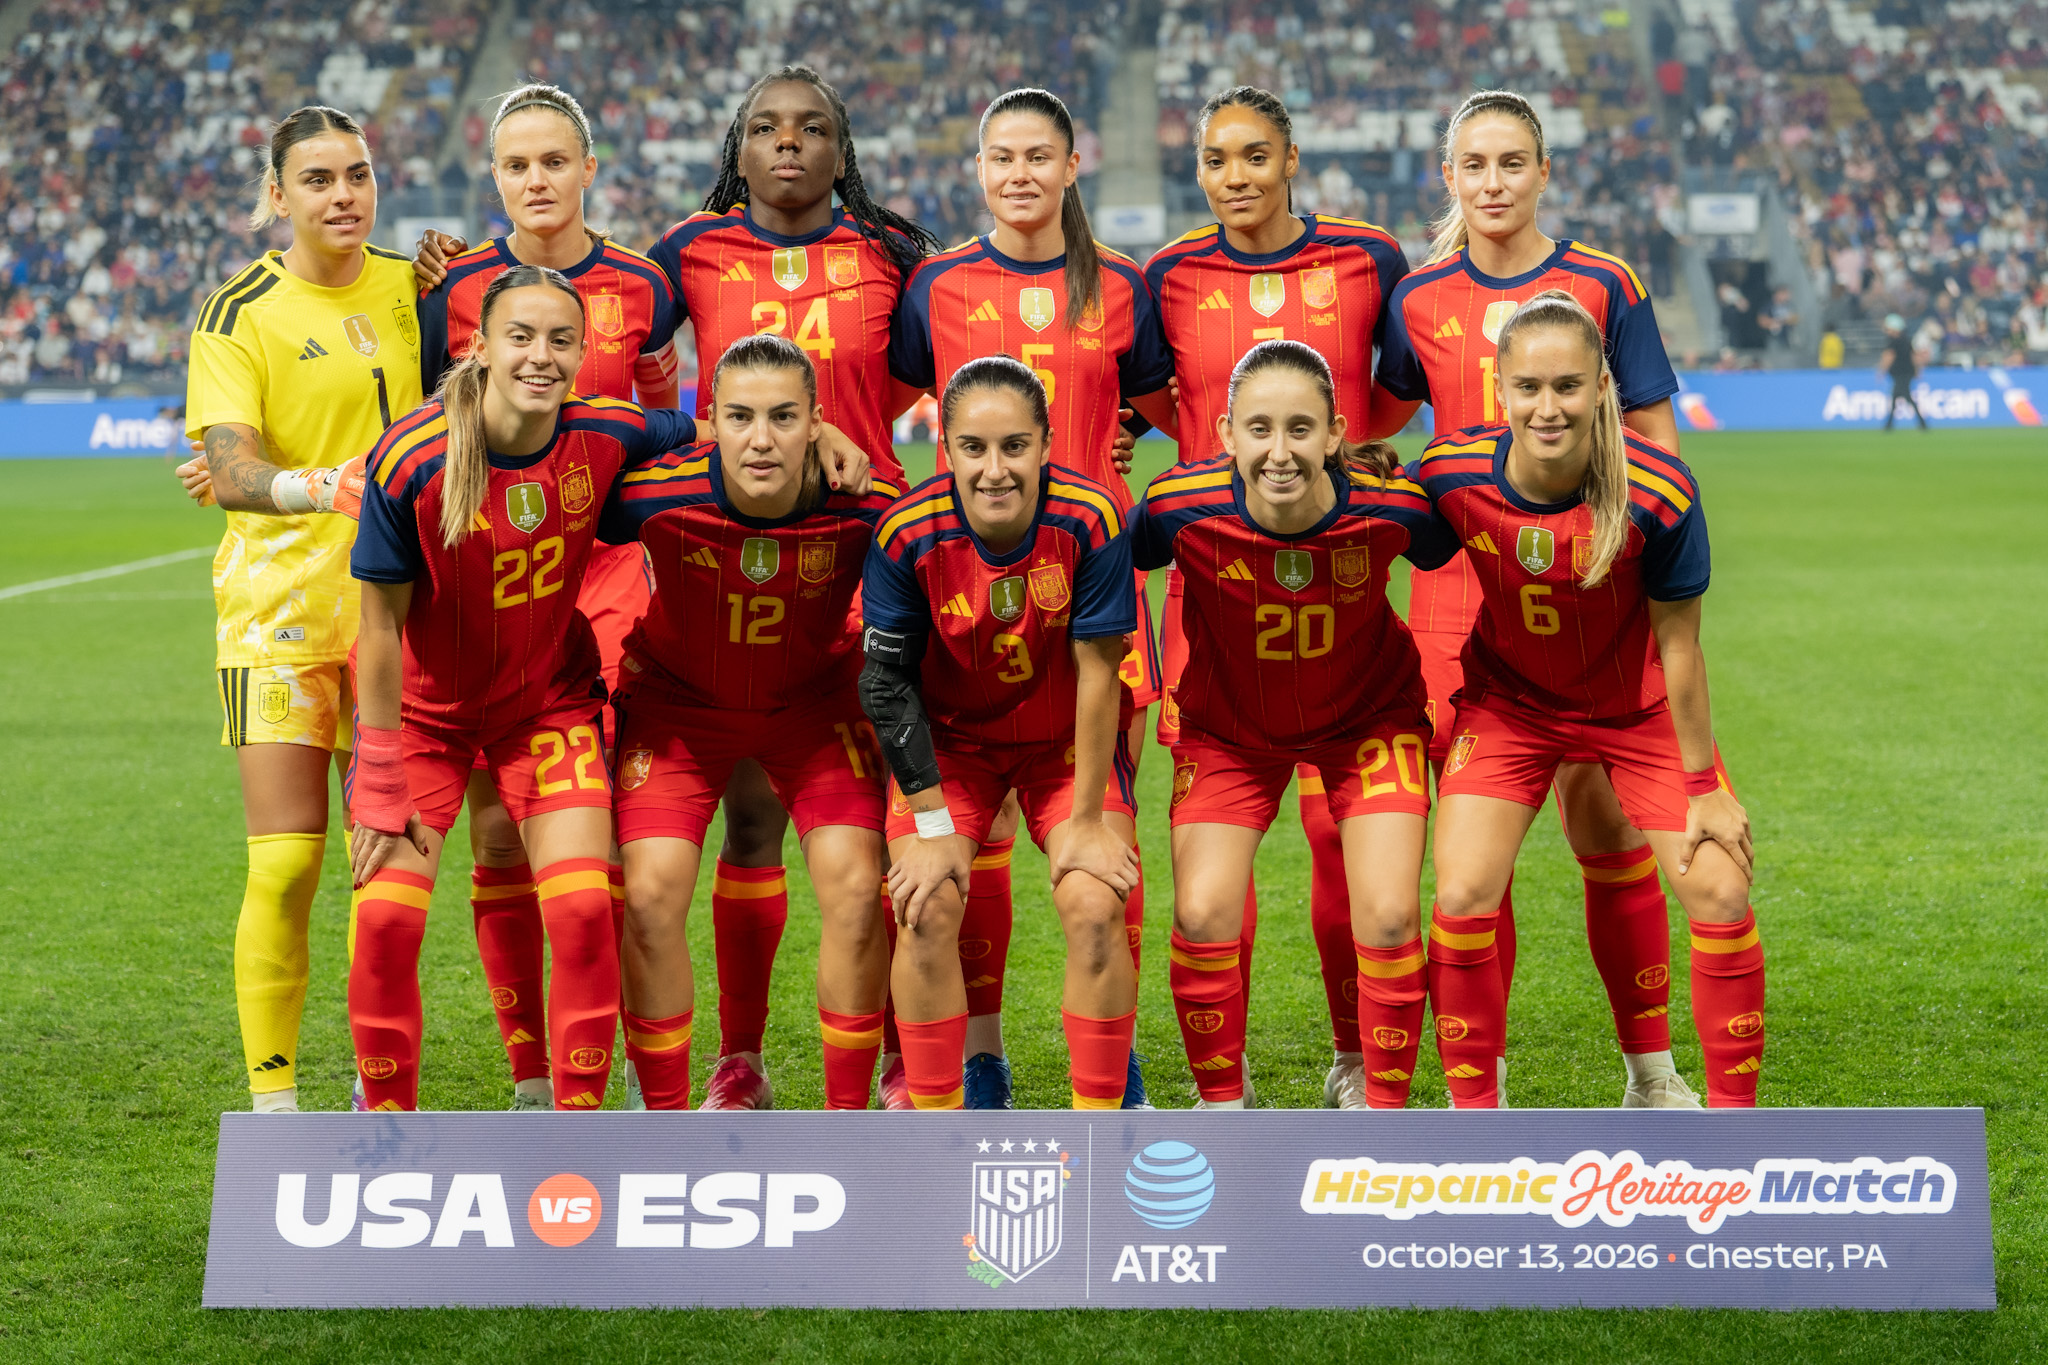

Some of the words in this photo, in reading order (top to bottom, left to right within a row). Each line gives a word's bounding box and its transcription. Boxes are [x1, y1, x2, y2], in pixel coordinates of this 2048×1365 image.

[751, 298, 836, 359] 24
[371, 366, 392, 432] 1
[1822, 383, 1990, 421] Amican
[520, 513, 538, 522] FIFA
[493, 535, 565, 610] 22
[1526, 556, 1544, 565] FIFA
[728, 592, 785, 645] 12
[1002, 605, 1019, 614] FIFA
[1255, 603, 1335, 661] 20
[1520, 584, 1561, 635] 6
[993, 633, 1034, 684] 3
[530, 725, 606, 797] 22
[1356, 733, 1425, 799] 20
[272, 1172, 516, 1249] USA
[616, 1171, 847, 1249] ESP
[979, 1169, 1056, 1214] USA
[1312, 1168, 1558, 1209] Hispanic
[1562, 1162, 1752, 1223] Heritage
[1759, 1168, 1946, 1204] Match
[1111, 1245, 1228, 1284] AT&T
[1362, 1243, 1510, 1269] October
[1518, 1244, 1566, 1273] 13,
[1573, 1243, 1659, 1269] 2026
[1685, 1242, 1835, 1273] Chester,
[1842, 1243, 1889, 1269] PA
